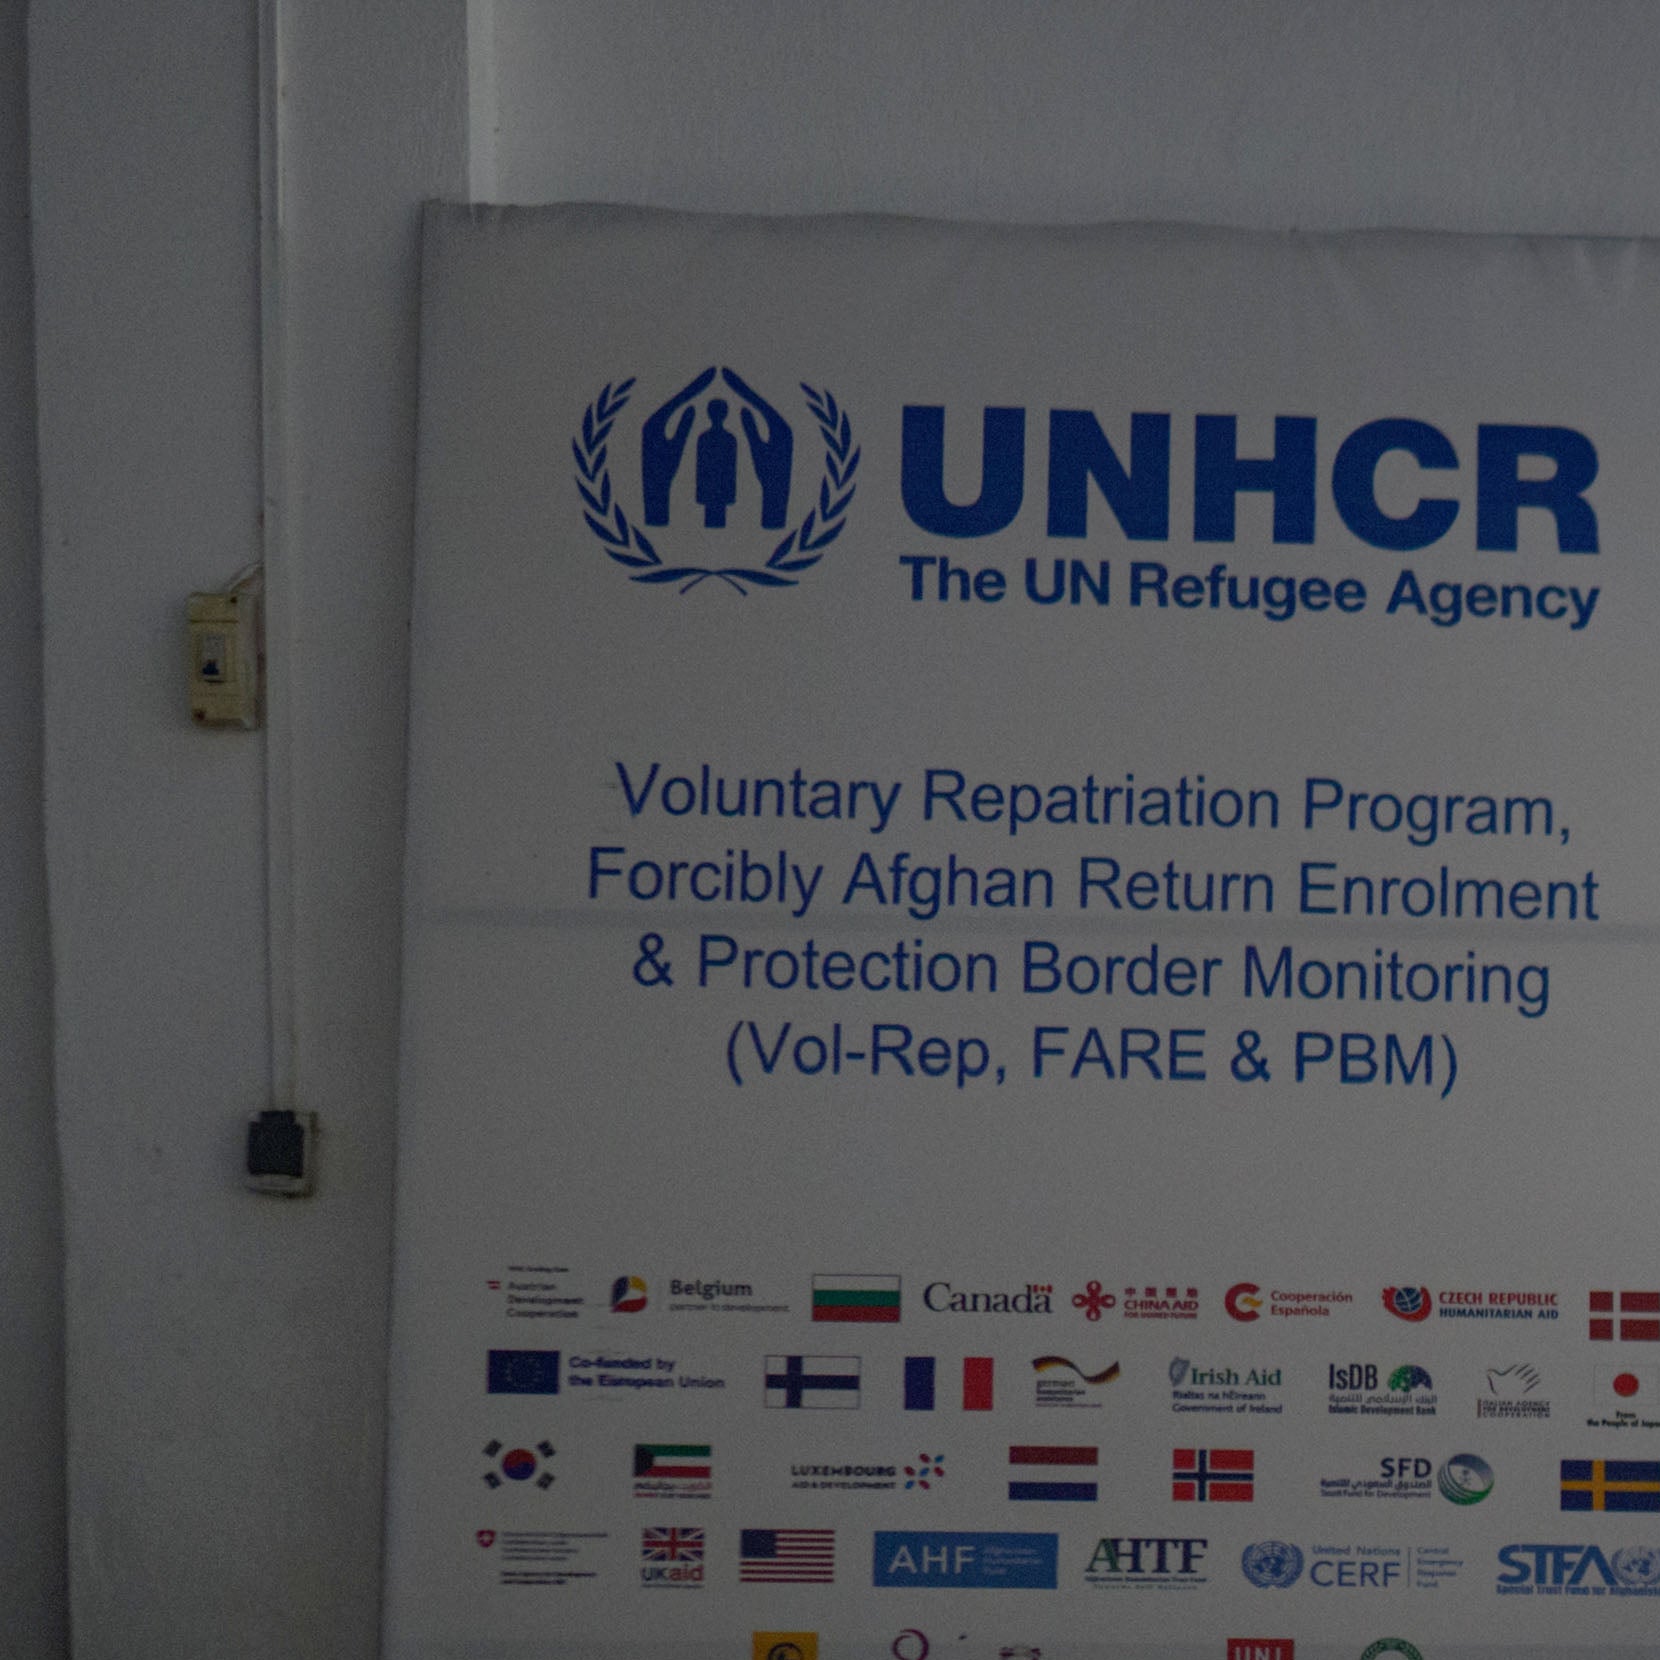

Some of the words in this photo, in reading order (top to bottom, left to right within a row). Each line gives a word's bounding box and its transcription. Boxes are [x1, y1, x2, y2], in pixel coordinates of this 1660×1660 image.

[899, 404, 1599, 554] UNHCR
[899, 555, 1007, 604] The
[1025, 558, 1110, 606] UN
[1129, 561, 1367, 622] Refugee
[1386, 569, 1600, 631] Agency
[615, 761, 902, 830] Voluntary
[923, 768, 1279, 836] Repatriation
[1304, 777, 1570, 848] Program,
[588, 845, 824, 919] Forcibly
[842, 851, 1054, 922] Afghan
[1079, 856, 1274, 913] Return
[1299, 861, 1599, 921] Enrolment
[632, 932, 674, 988] &
[698, 933, 998, 993] Protection
[1023, 939, 1223, 997] Border
[1243, 944, 1550, 1019] Monitoring
[726, 1021, 1006, 1089] (Vol-Rep,
[1033, 1026, 1207, 1081] FARE
[1230, 1029, 1271, 1083] &
[1295, 1031, 1458, 1098] PBM)
[670, 1280, 752, 1301] Belgium
[923, 1282, 1053, 1313] Canada
[1271, 1290, 1353, 1303] Cooperación
[1439, 1292, 1482, 1304] CZECH
[1489, 1293, 1559, 1306] REPUBLIC
[1125, 1300, 1171, 1311] CHINA
[1173, 1300, 1199, 1311] AID
[1271, 1305, 1329, 1317] Española
[1440, 1308, 1533, 1319] HUMANITARIAN
[1537, 1309, 1559, 1319] AID
[1192, 1367, 1239, 1386] Irish
[1245, 1367, 1282, 1386] Aid
[1329, 1363, 1378, 1391] IsDB
[1381, 1457, 1432, 1480] SFD
[888, 1545, 976, 1575] AHF
[1085, 1537, 1208, 1574] AHTF
[1310, 1560, 1401, 1588] CERF
